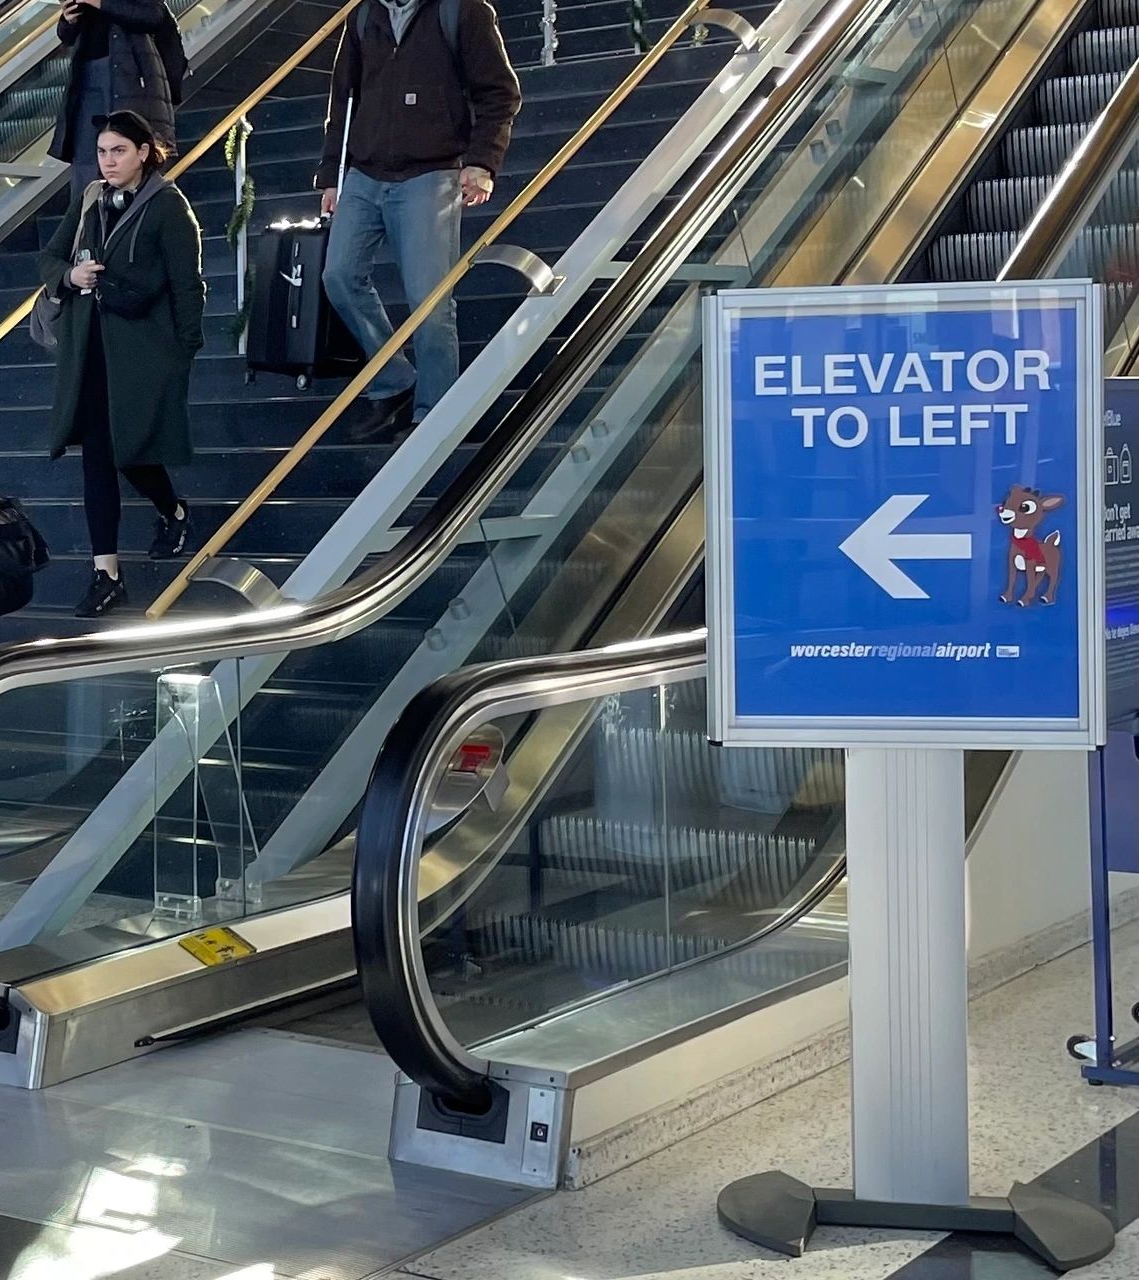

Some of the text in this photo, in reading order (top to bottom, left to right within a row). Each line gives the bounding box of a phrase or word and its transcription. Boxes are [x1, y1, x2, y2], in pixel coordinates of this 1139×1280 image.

[754, 349, 1051, 396] ELEVATOR
[791, 403, 1029, 449] TO LEFT
[1104, 523, 1126, 542] arried
